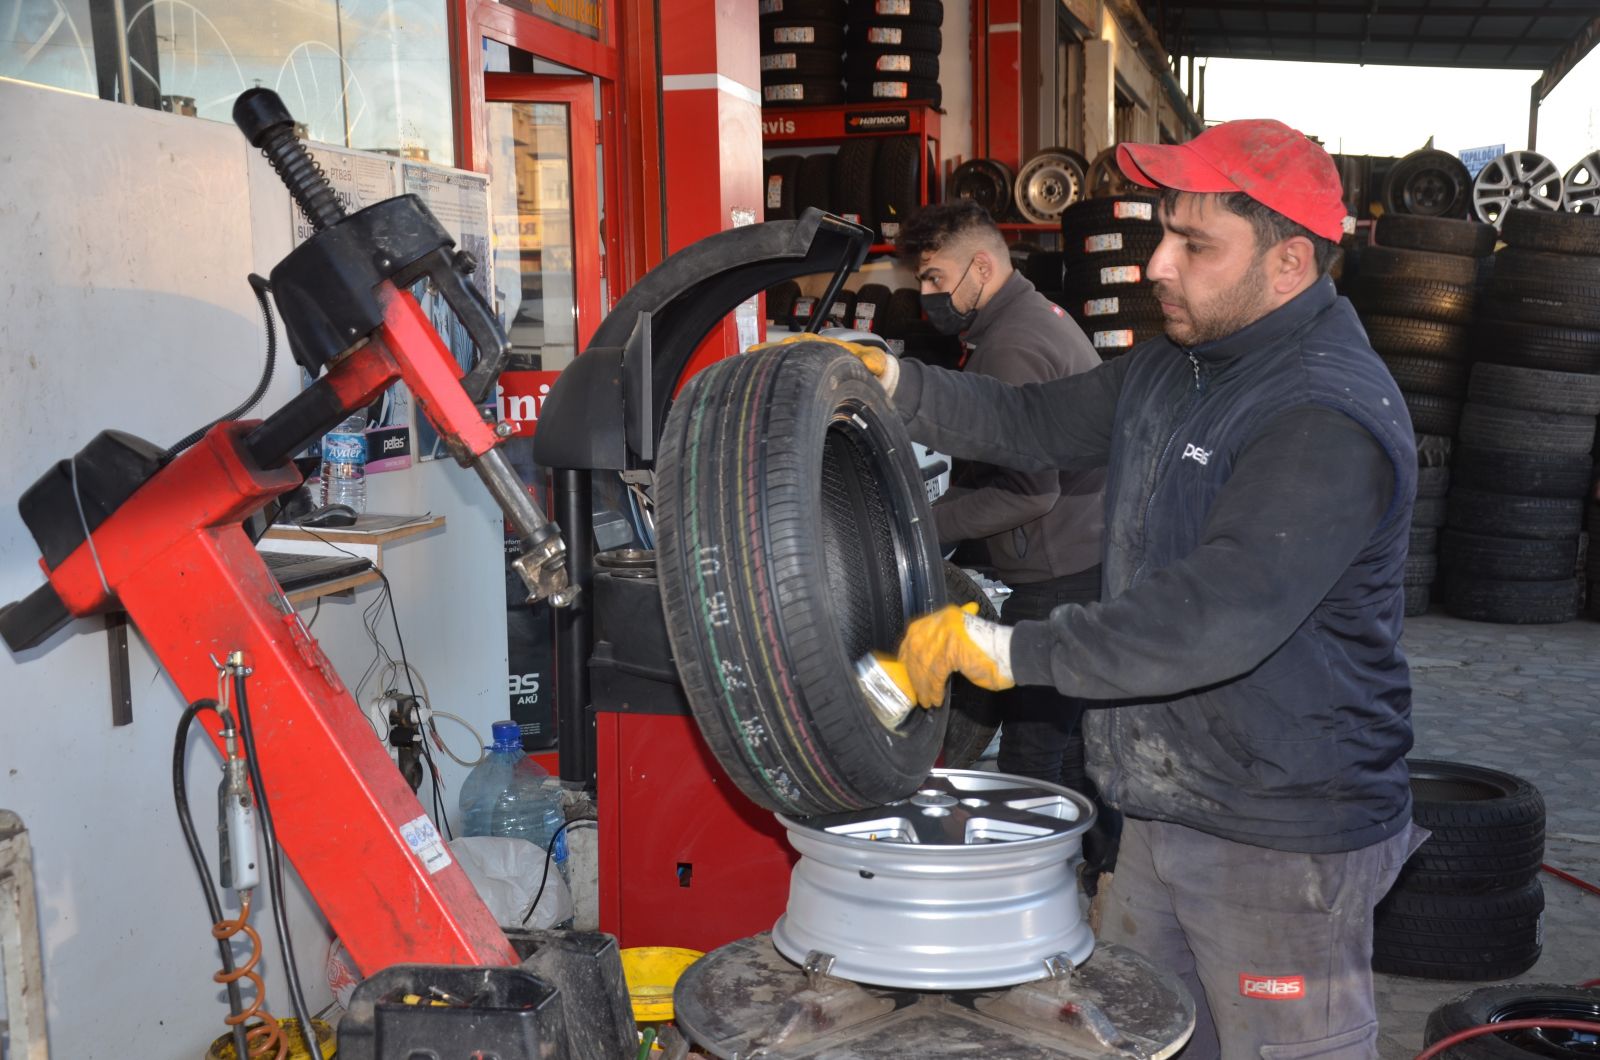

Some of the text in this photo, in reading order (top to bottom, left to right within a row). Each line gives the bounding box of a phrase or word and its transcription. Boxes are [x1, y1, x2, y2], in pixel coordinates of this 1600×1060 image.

[328, 446, 361, 459] Ayder
[517, 693, 538, 705] AKÜ
[1244, 979, 1301, 995] petlas
